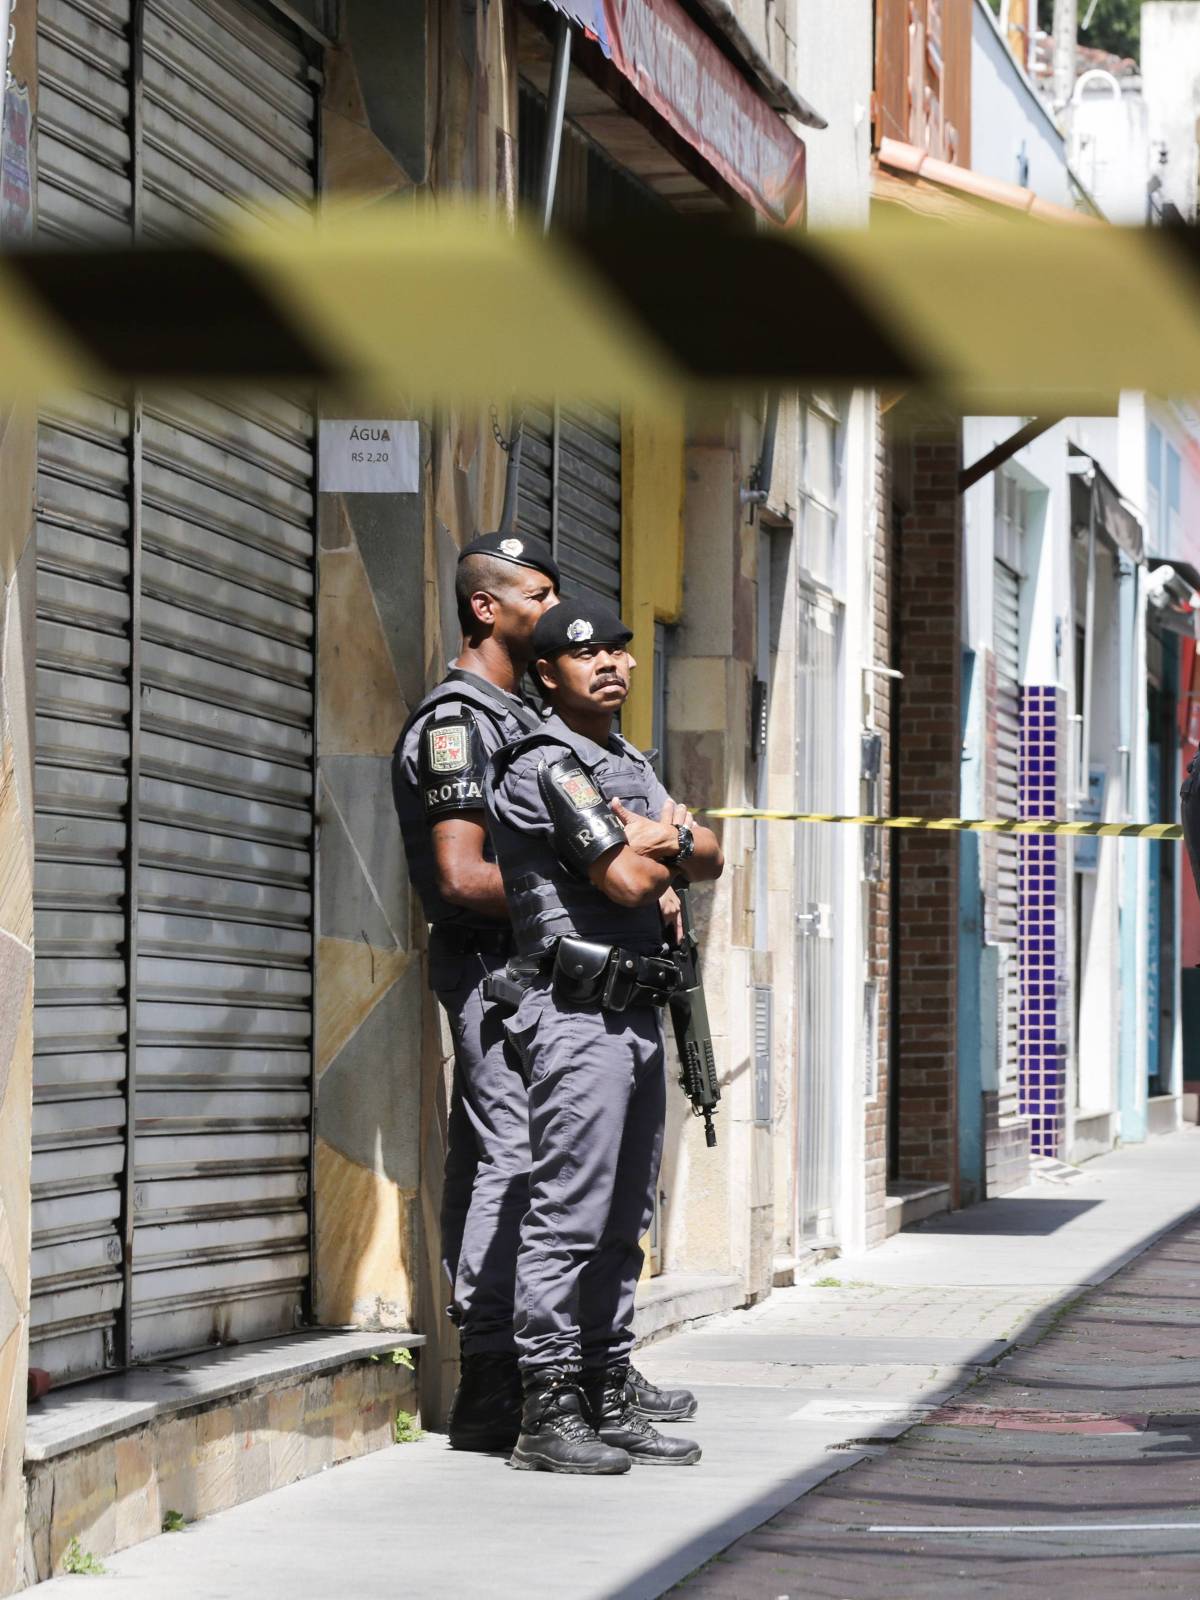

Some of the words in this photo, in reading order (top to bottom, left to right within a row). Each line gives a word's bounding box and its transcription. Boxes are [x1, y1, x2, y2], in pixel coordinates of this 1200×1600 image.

[350, 425, 391, 441] ÁGUA
[351, 452, 364, 463] R$
[367, 452, 389, 464] 2,20
[426, 781, 483, 806] ROTA
